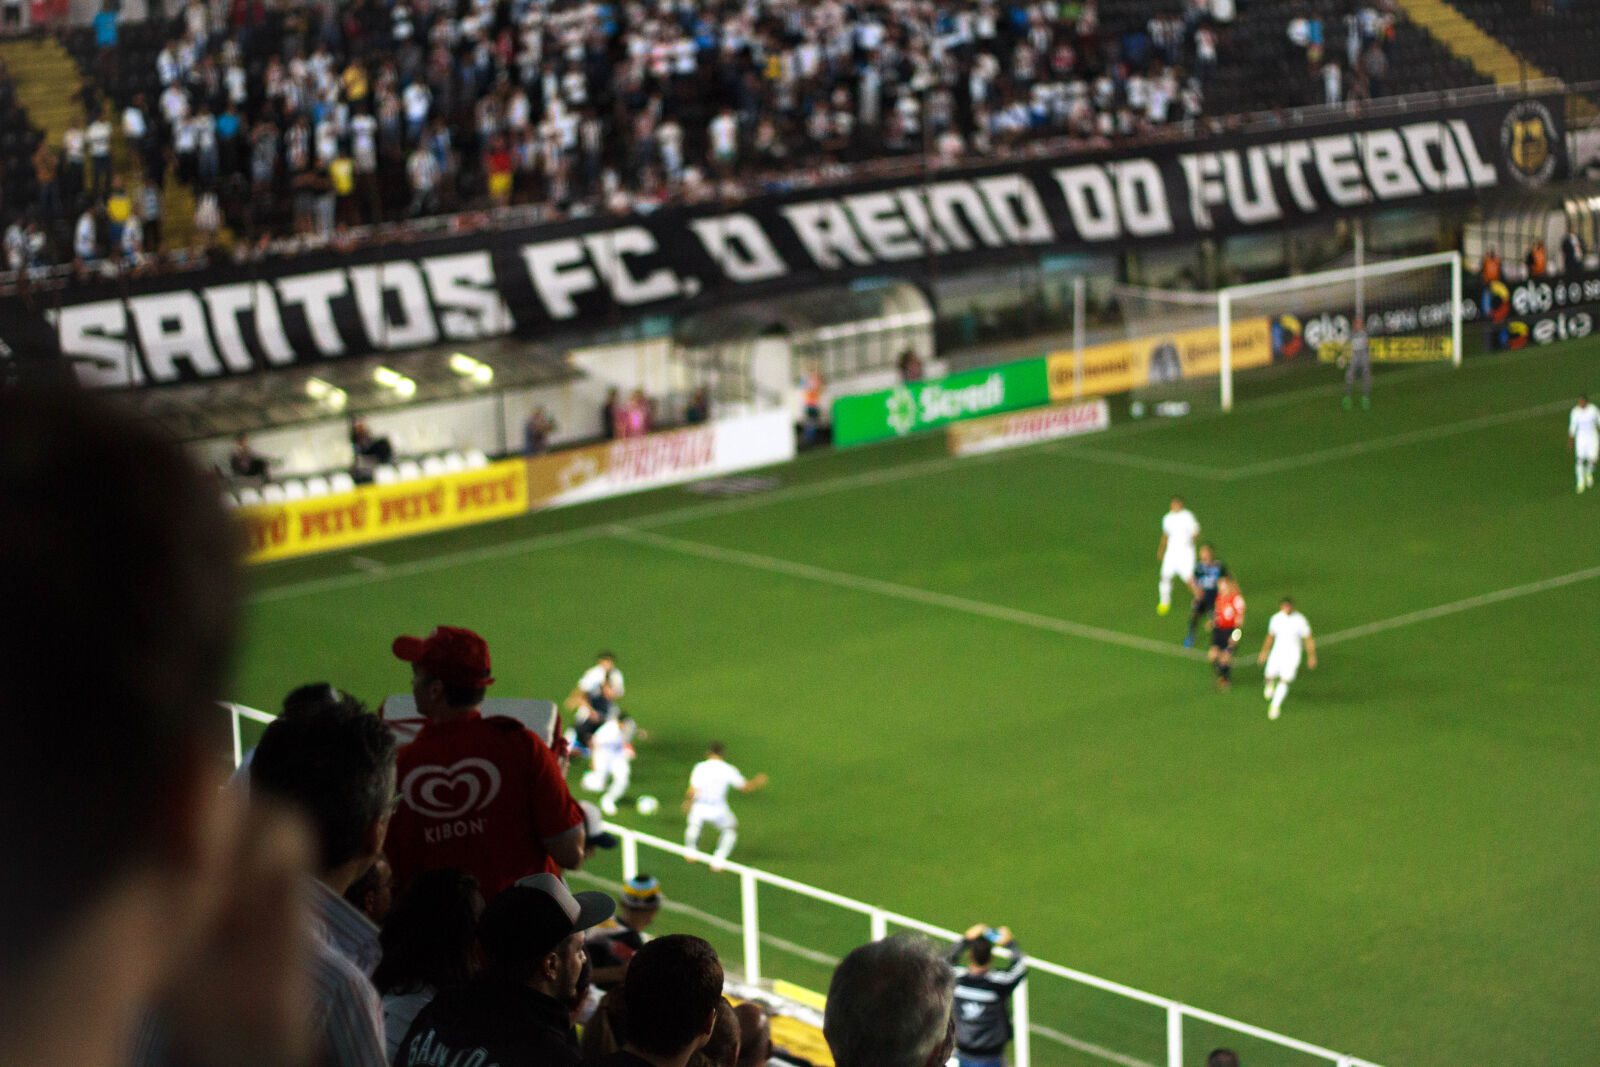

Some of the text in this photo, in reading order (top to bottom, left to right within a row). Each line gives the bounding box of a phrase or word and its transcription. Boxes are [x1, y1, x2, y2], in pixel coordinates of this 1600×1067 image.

[47, 250, 517, 388] SANTOS
[521, 225, 700, 320] FC.
[689, 212, 790, 283] O
[779, 172, 1056, 271] REINO
[1052, 156, 1174, 243] DO
[1179, 118, 1498, 231] FUTEBOL
[1512, 279, 1553, 317] elo
[1533, 312, 1593, 345] elo
[423, 817, 485, 843] KIBON
